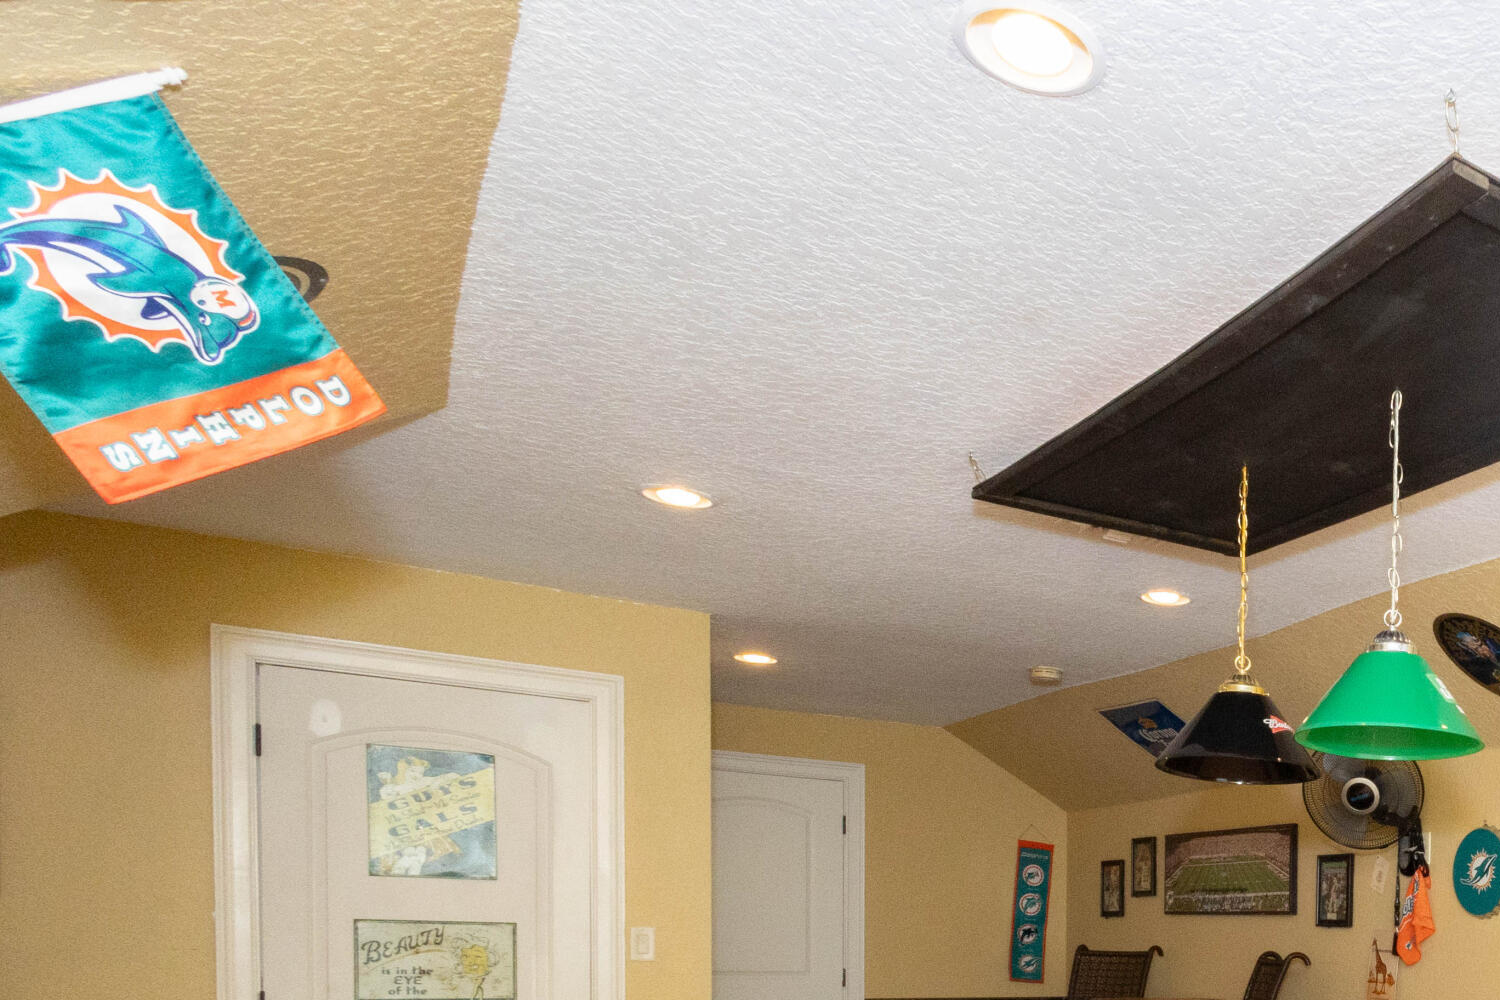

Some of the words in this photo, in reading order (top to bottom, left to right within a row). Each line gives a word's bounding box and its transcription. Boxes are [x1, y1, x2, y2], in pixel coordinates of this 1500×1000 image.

[100, 374, 352, 473] DOLPHINS
[387, 776, 478, 811] GUYS
[388, 803, 479, 837] GALS
[361, 925, 445, 965] BEAUTY
[381, 967, 391, 975] is
[396, 967, 408, 975] in
[412, 966, 434, 975] the
[393, 976, 423, 985] EYE
[388, 986, 401, 996] of
[405, 986, 428, 996] the
